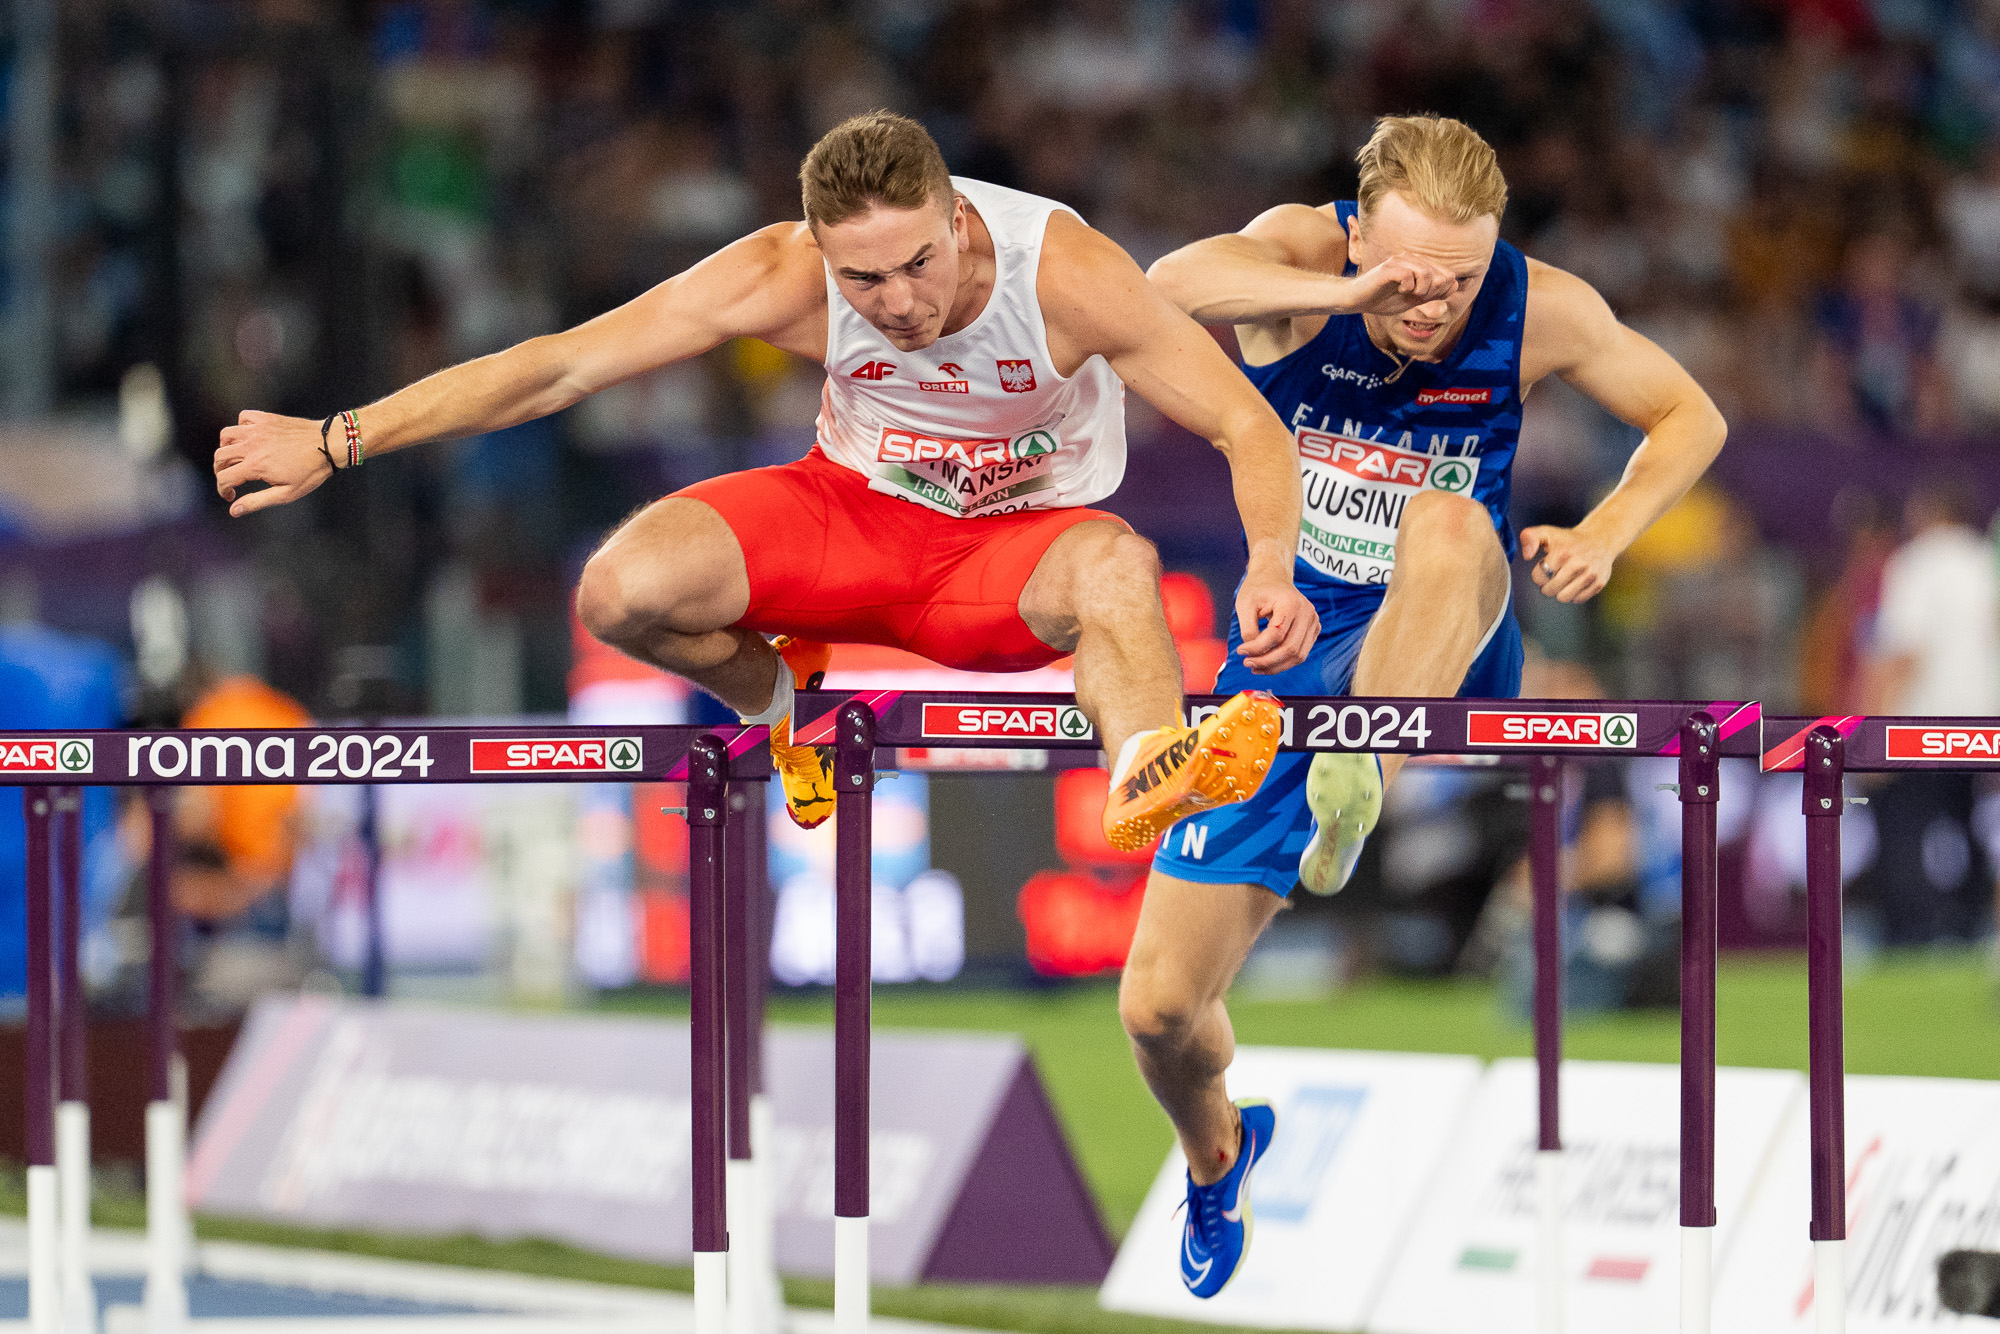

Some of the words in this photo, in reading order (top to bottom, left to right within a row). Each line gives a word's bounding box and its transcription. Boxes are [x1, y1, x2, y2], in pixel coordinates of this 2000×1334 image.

[851, 361, 897, 380] 4F
[921, 382, 966, 393] ORLEN
[881, 433, 1006, 469] SPAR
[1300, 435, 1426, 483] SPAR
[913, 479, 922, 491] I
[922, 482, 957, 508] RUN
[1311, 526, 1317, 539] I
[1317, 530, 1352, 552] RUN
[1301, 538, 1360, 581] ROMA
[958, 709, 1054, 733] SPAR
[1306, 704, 1432, 748] 2024
[1503, 717, 1598, 741] SPAR
[1922, 732, 2000, 755] SPA
[0, 744, 54, 767] AR
[128, 736, 295, 778] roma
[308, 734, 435, 778] 2024
[507, 744, 603, 767] SPAR
[1121, 729, 1199, 804] NITRO
